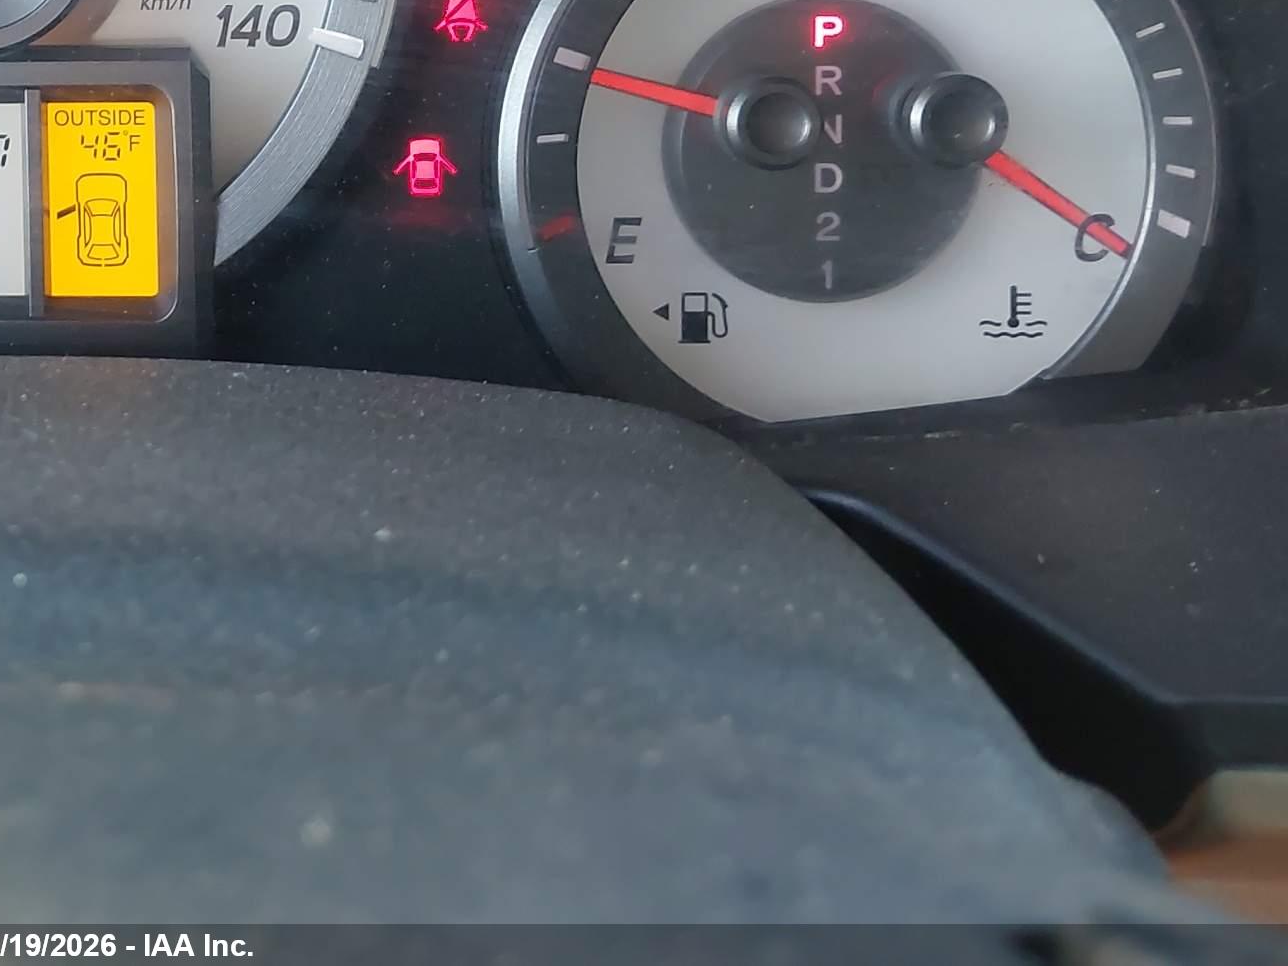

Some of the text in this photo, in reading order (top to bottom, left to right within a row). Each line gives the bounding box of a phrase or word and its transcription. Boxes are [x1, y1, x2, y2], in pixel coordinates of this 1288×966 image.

[217, 5, 300, 50] 140
[812, 15, 845, 48] P
[814, 66, 843, 97] R
[53, 109, 146, 127] OUTSIDE
[823, 114, 843, 144] N
[814, 163, 843, 194] D
[605, 217, 643, 265] E
[815, 212, 842, 242] 2
[1073, 213, 1115, 262] C
[820, 260, 833, 290] 1
